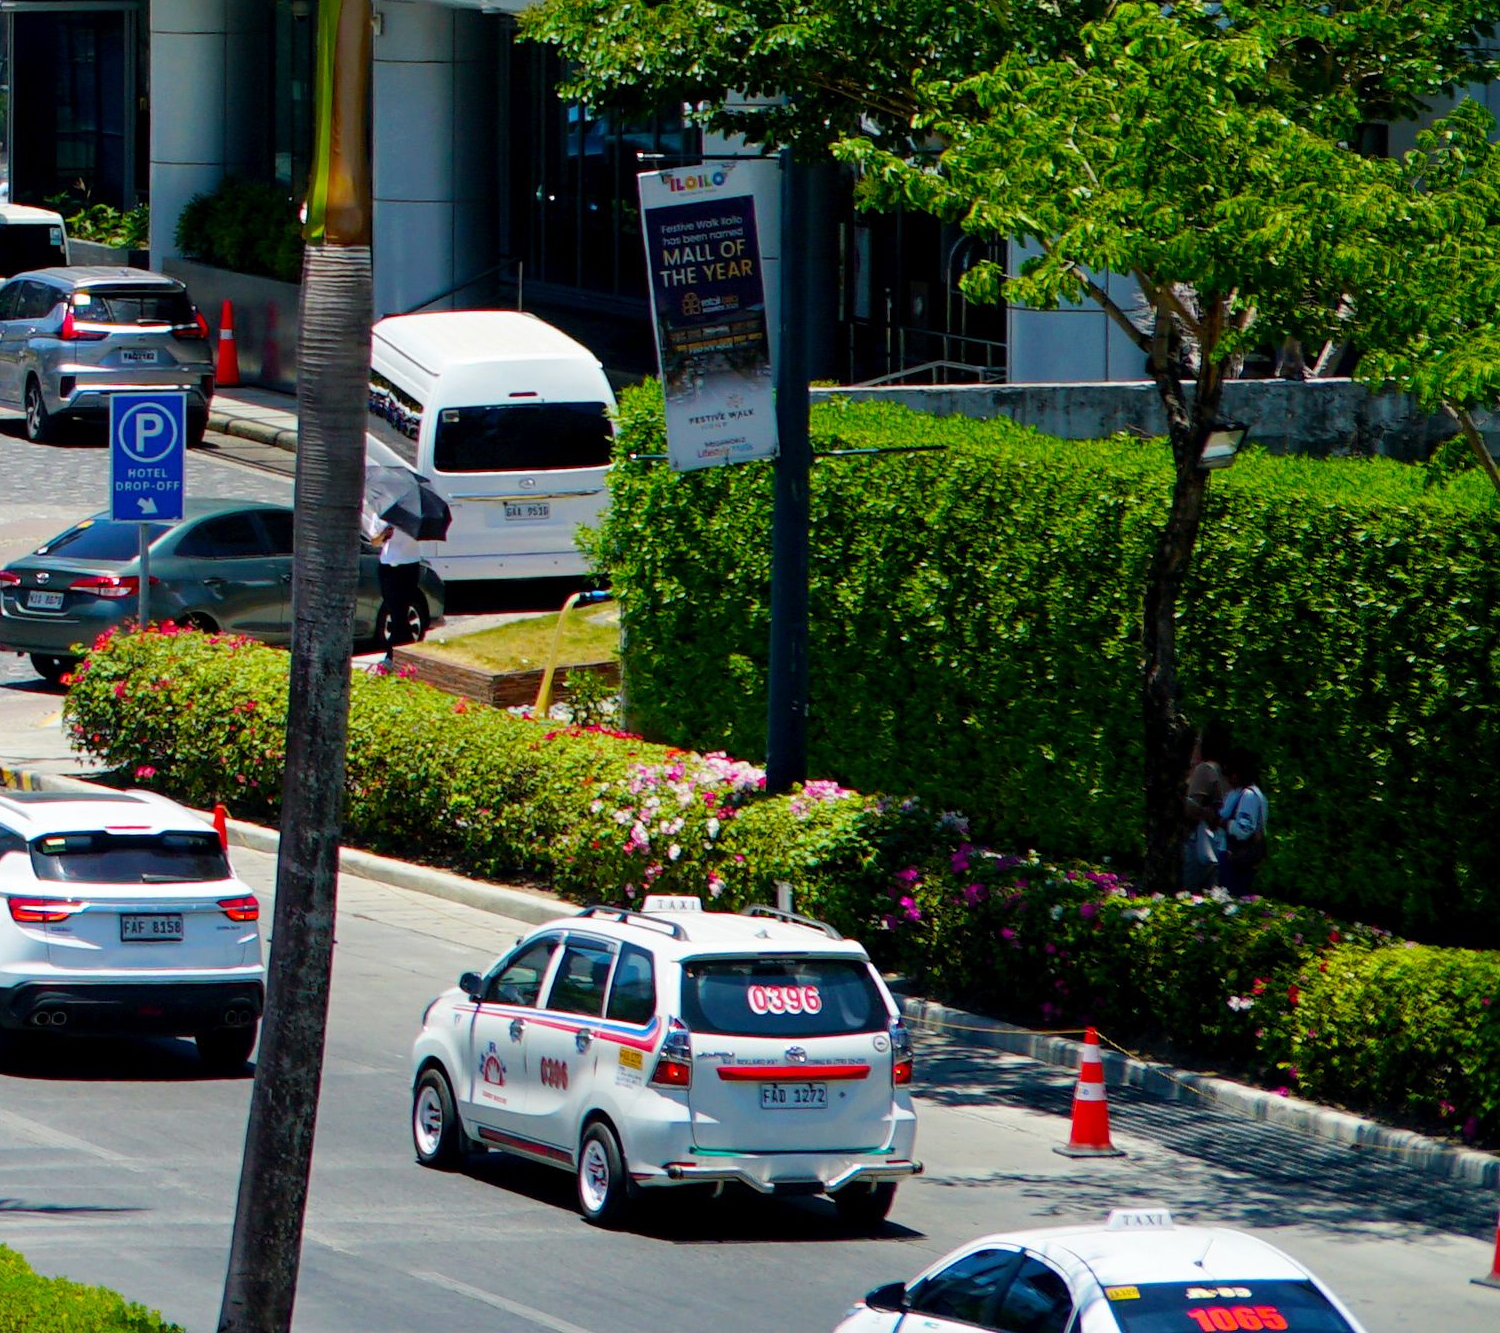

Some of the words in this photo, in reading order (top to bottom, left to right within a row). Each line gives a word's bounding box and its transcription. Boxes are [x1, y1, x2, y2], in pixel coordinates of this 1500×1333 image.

[669, 171, 727, 192] ILOILO
[661, 221, 695, 234] Festive
[696, 218, 719, 230] Walk
[662, 236, 681, 246] has
[683, 232, 708, 244] been
[709, 228, 744, 240] named
[662, 243, 716, 267] MALL
[720, 239, 747, 259] OF
[659, 266, 698, 288] THE
[702, 259, 754, 282] YEAR
[688, 412, 726, 425] FESTIVE
[729, 409, 754, 421] WALK
[136, 413, 164, 453] P
[127, 468, 168, 479] HOTEL
[115, 480, 181, 492] DROP-OFF
[123, 921, 145, 933] FAF
[152, 921, 182, 933] 8158
[747, 985, 822, 1015] 0396
[794, 1090, 826, 1103] 1272
[1123, 1214, 1163, 1226] TAXI
[1187, 1305, 1289, 1333] 1065
